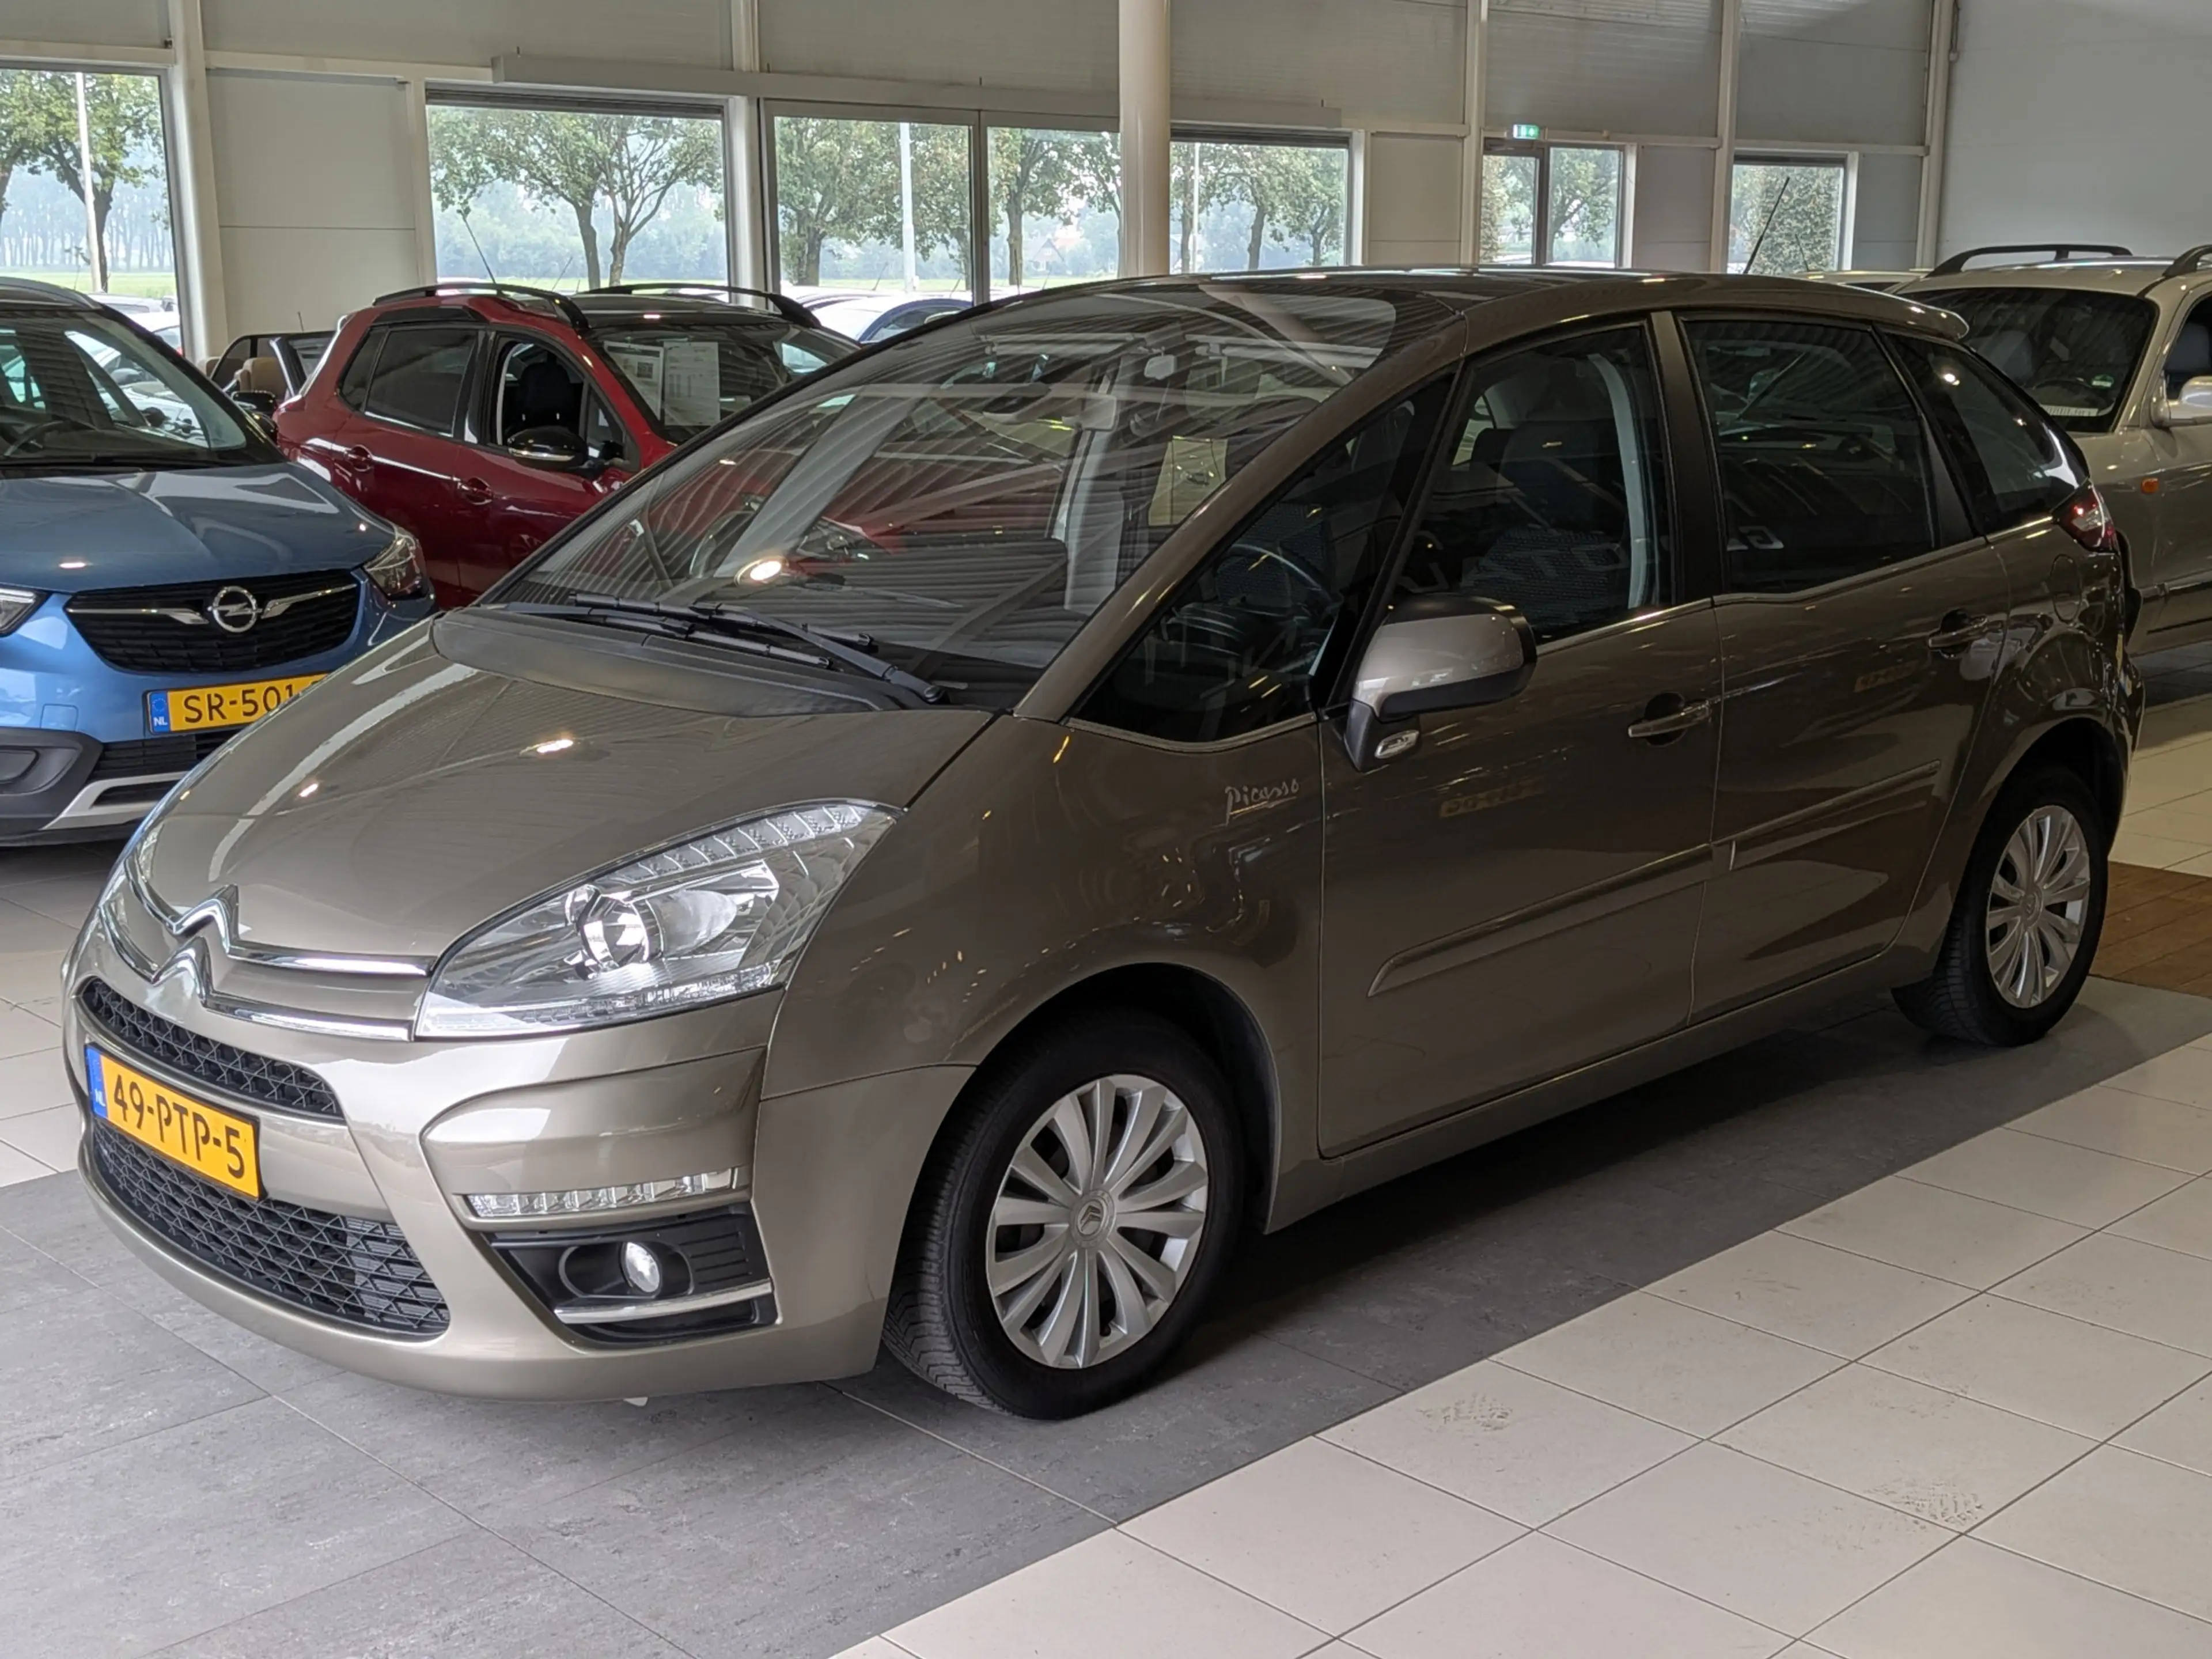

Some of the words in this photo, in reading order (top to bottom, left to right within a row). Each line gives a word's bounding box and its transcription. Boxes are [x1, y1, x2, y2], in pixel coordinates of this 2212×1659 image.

[154, 717, 168, 726] NL
[1225, 778, 1299, 826] Picasso
[114, 1074, 245, 1179] 49-PTP-5
